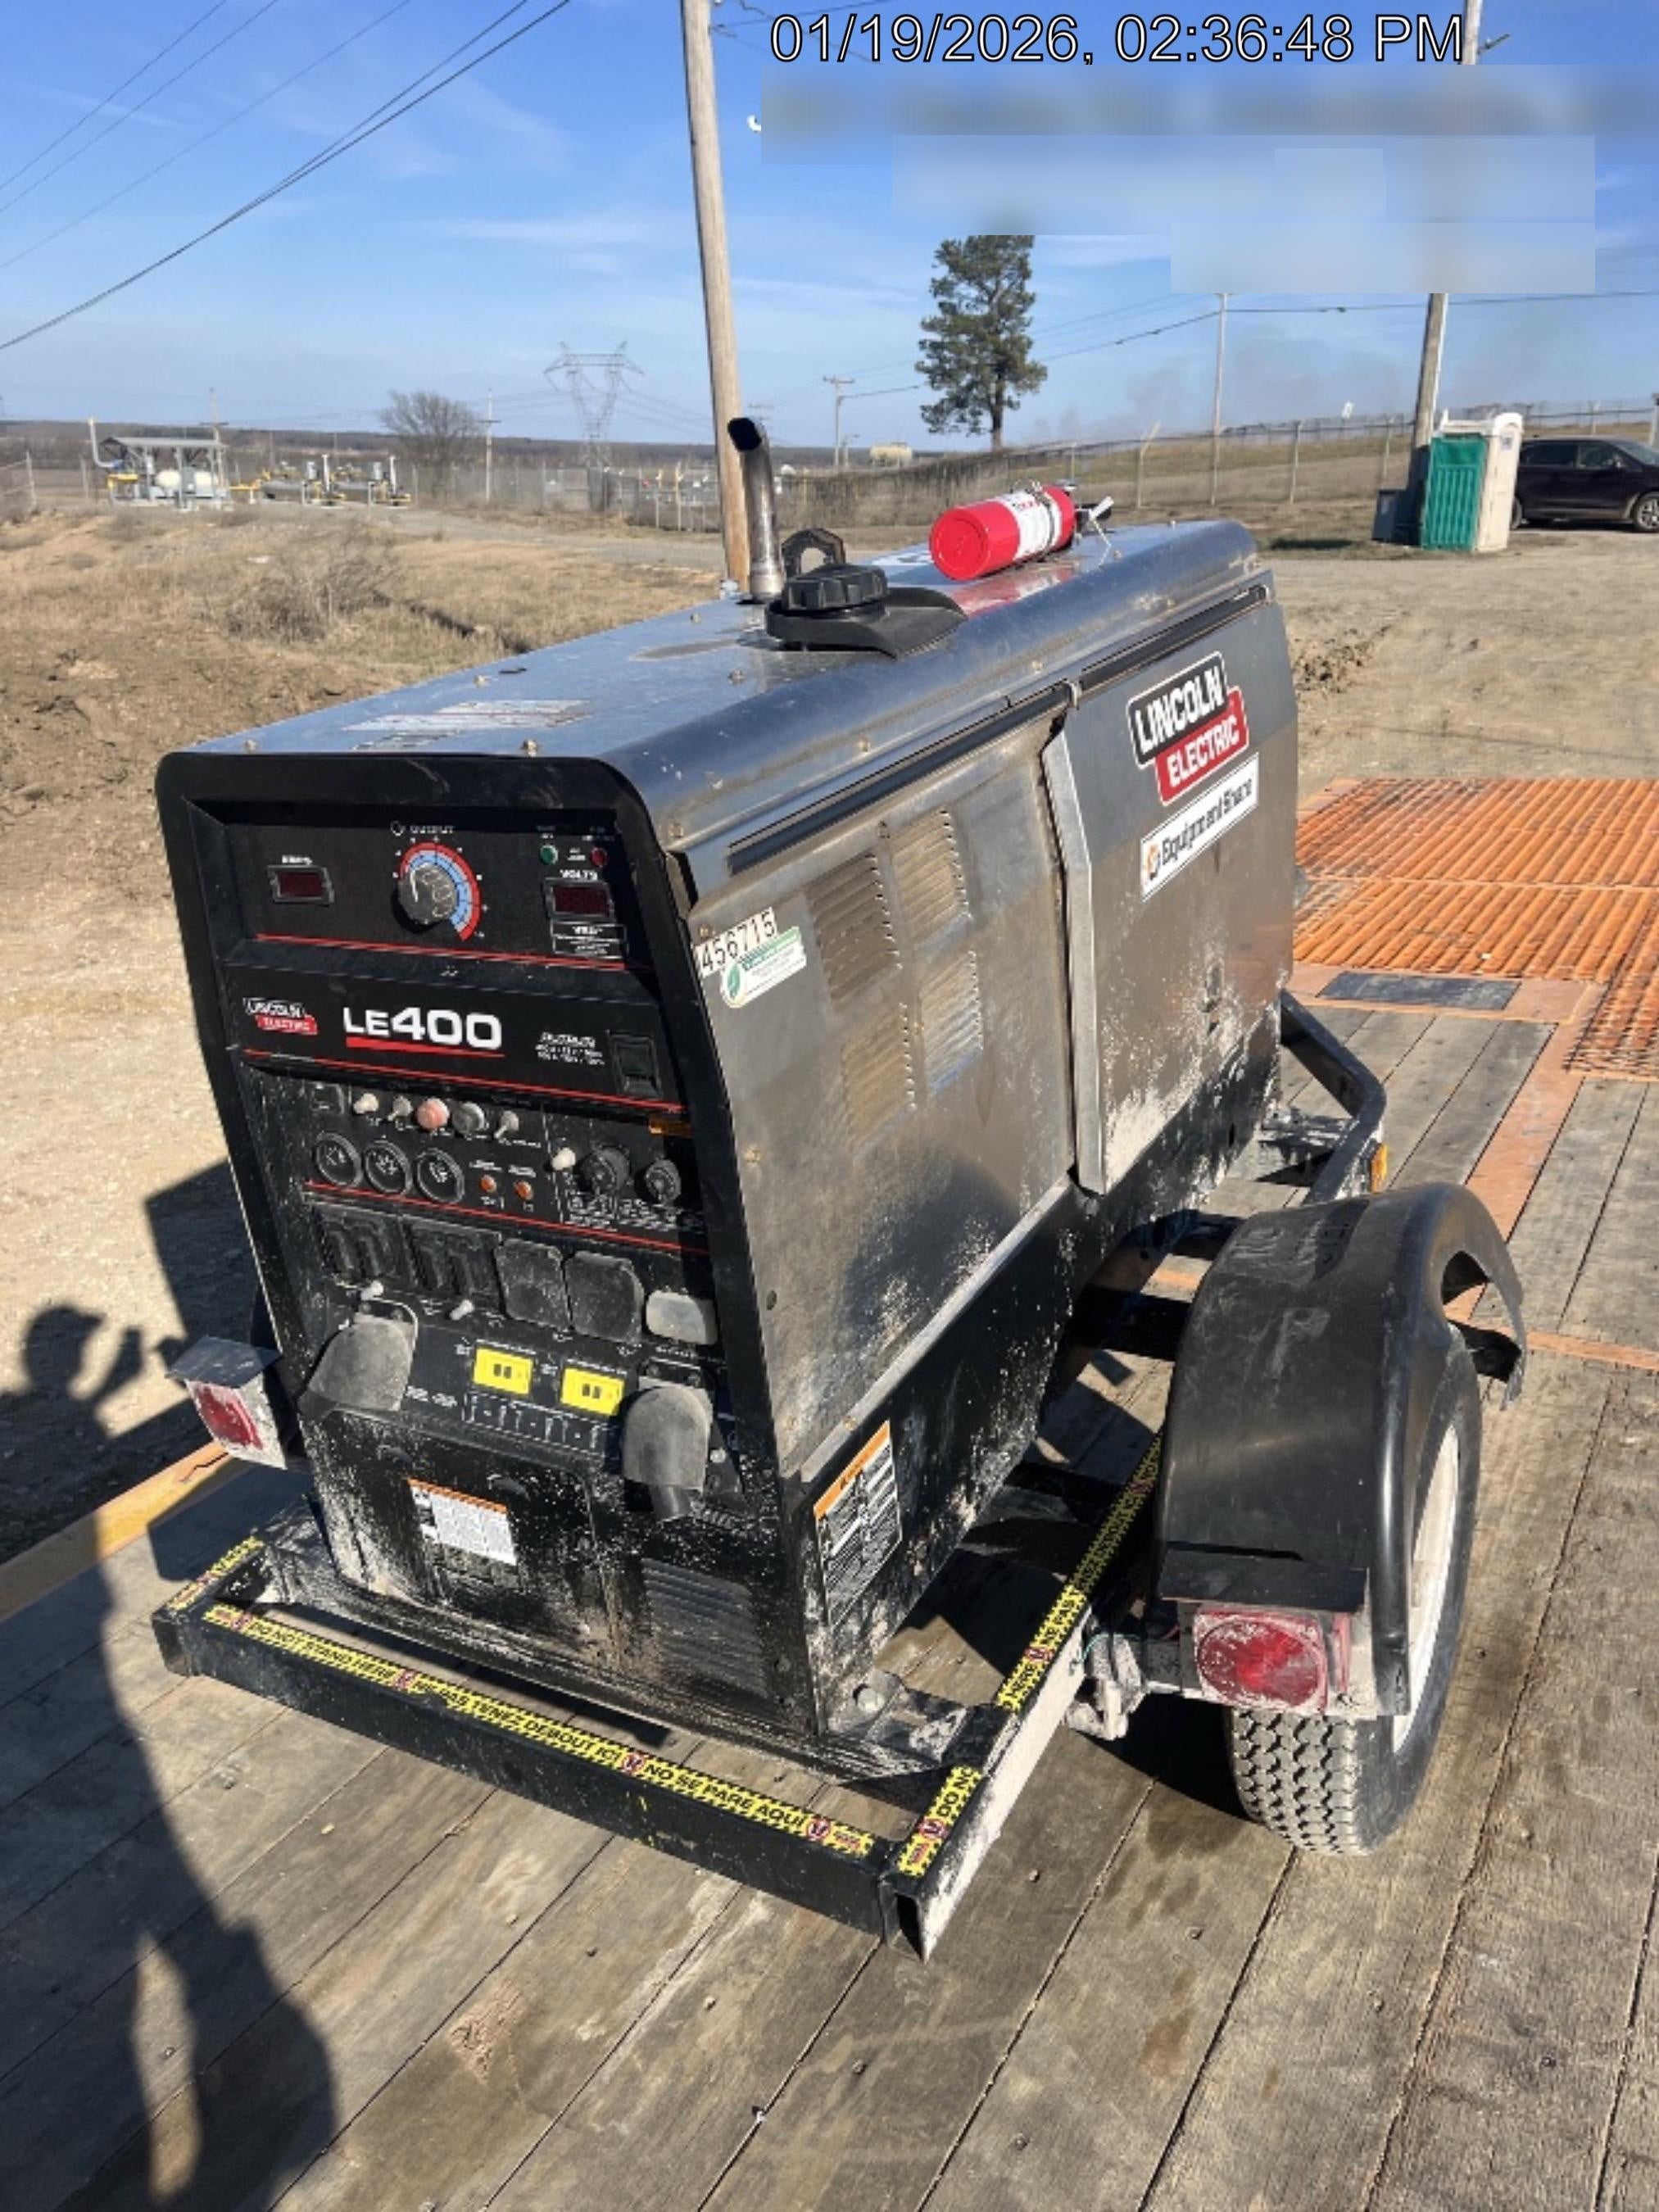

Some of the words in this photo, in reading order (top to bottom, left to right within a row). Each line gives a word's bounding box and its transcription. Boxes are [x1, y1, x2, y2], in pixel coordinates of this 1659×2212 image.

[1135, 665, 1225, 755] LINCOLN
[1167, 714, 1240, 787] ELECTRIC
[342, 1007, 503, 1050] LE400
[301, 1640, 351, 1666] STAND
[351, 1657, 397, 1679] HERE
[525, 1720, 596, 1752] DEBOUT
[644, 1764, 674, 1780] NO
[675, 1774, 704, 1790] SE
[702, 1784, 752, 1809] PARE
[936, 1791, 959, 1817] DO
